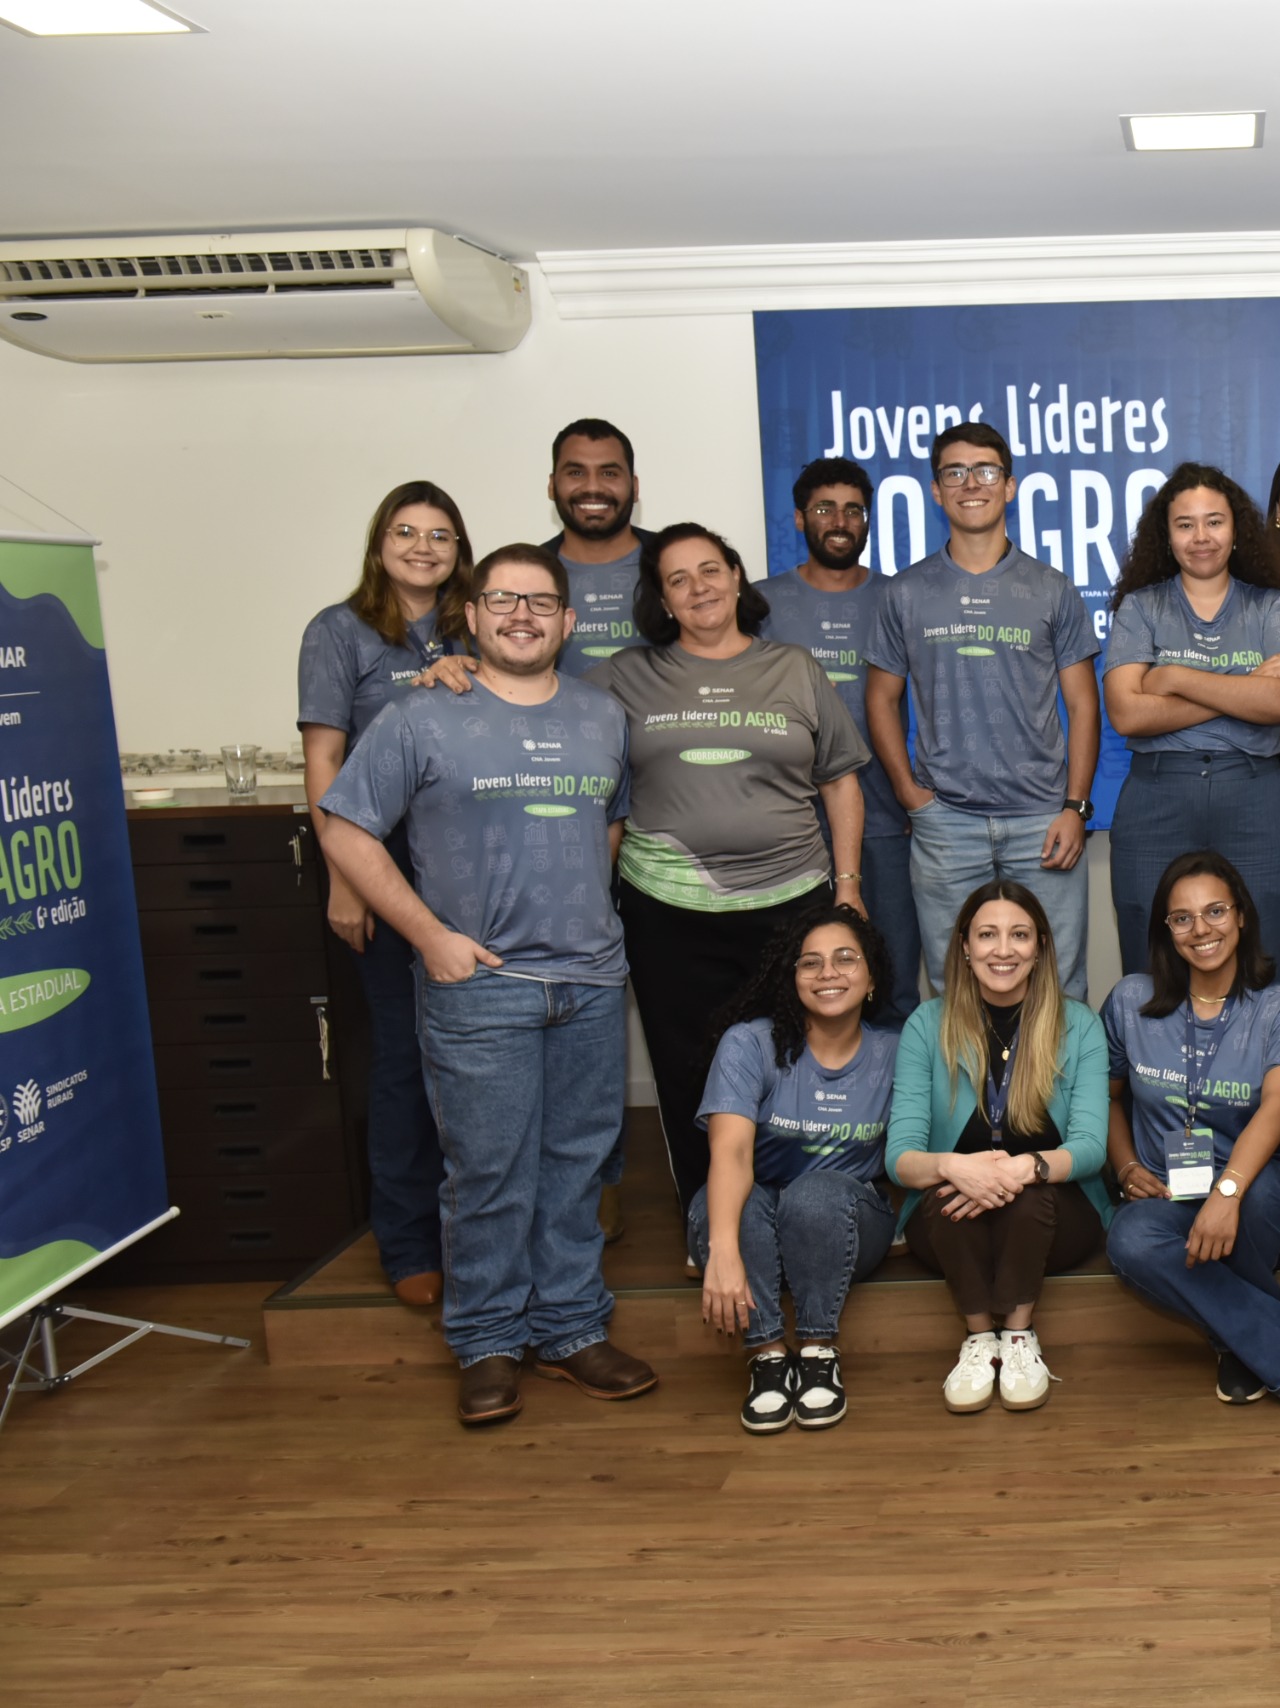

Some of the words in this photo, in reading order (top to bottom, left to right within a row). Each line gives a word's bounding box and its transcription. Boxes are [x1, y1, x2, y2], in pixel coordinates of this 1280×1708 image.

[1007, 382, 1169, 457] Líderes
[858, 475, 927, 577] O
[610, 620, 632, 639] DO
[923, 627, 948, 638] Jovens
[950, 623, 977, 635] Líderes
[977, 624, 994, 642] DO
[996, 626, 1031, 646] AGRO
[811, 646, 839, 659] Líderes
[839, 650, 857, 666] DO
[1183, 649, 1210, 663] Líderes
[1211, 653, 1229, 668] DO
[1231, 650, 1263, 667] AGRO
[391, 670, 420, 681] Jovens
[645, 713, 678, 726] Jovens
[681, 710, 718, 722] Líderes
[719, 710, 741, 728] DO
[744, 710, 787, 730] AGRO
[537, 741, 562, 749] SENAR
[686, 749, 745, 762] COORDENAÇÃO
[472, 776, 512, 792] Jovens
[515, 773, 552, 788] Líderes
[553, 775, 575, 796] DO
[0, 776, 73, 822] Líderes
[50, 896, 86, 924] edição
[9, 970, 81, 1012] ESTADUAL
[45, 1070, 88, 1097] SINDICATOS
[1135, 1062, 1161, 1079] Jovens
[1212, 1080, 1251, 1101] AGRO
[46, 1090, 74, 1109] RURAIS
[826, 1093, 847, 1101] SENAR
[17, 1121, 45, 1143] SENAR
[769, 1112, 800, 1131] Jovens
[802, 1119, 831, 1133] Líderes
[830, 1122, 851, 1142] DO
